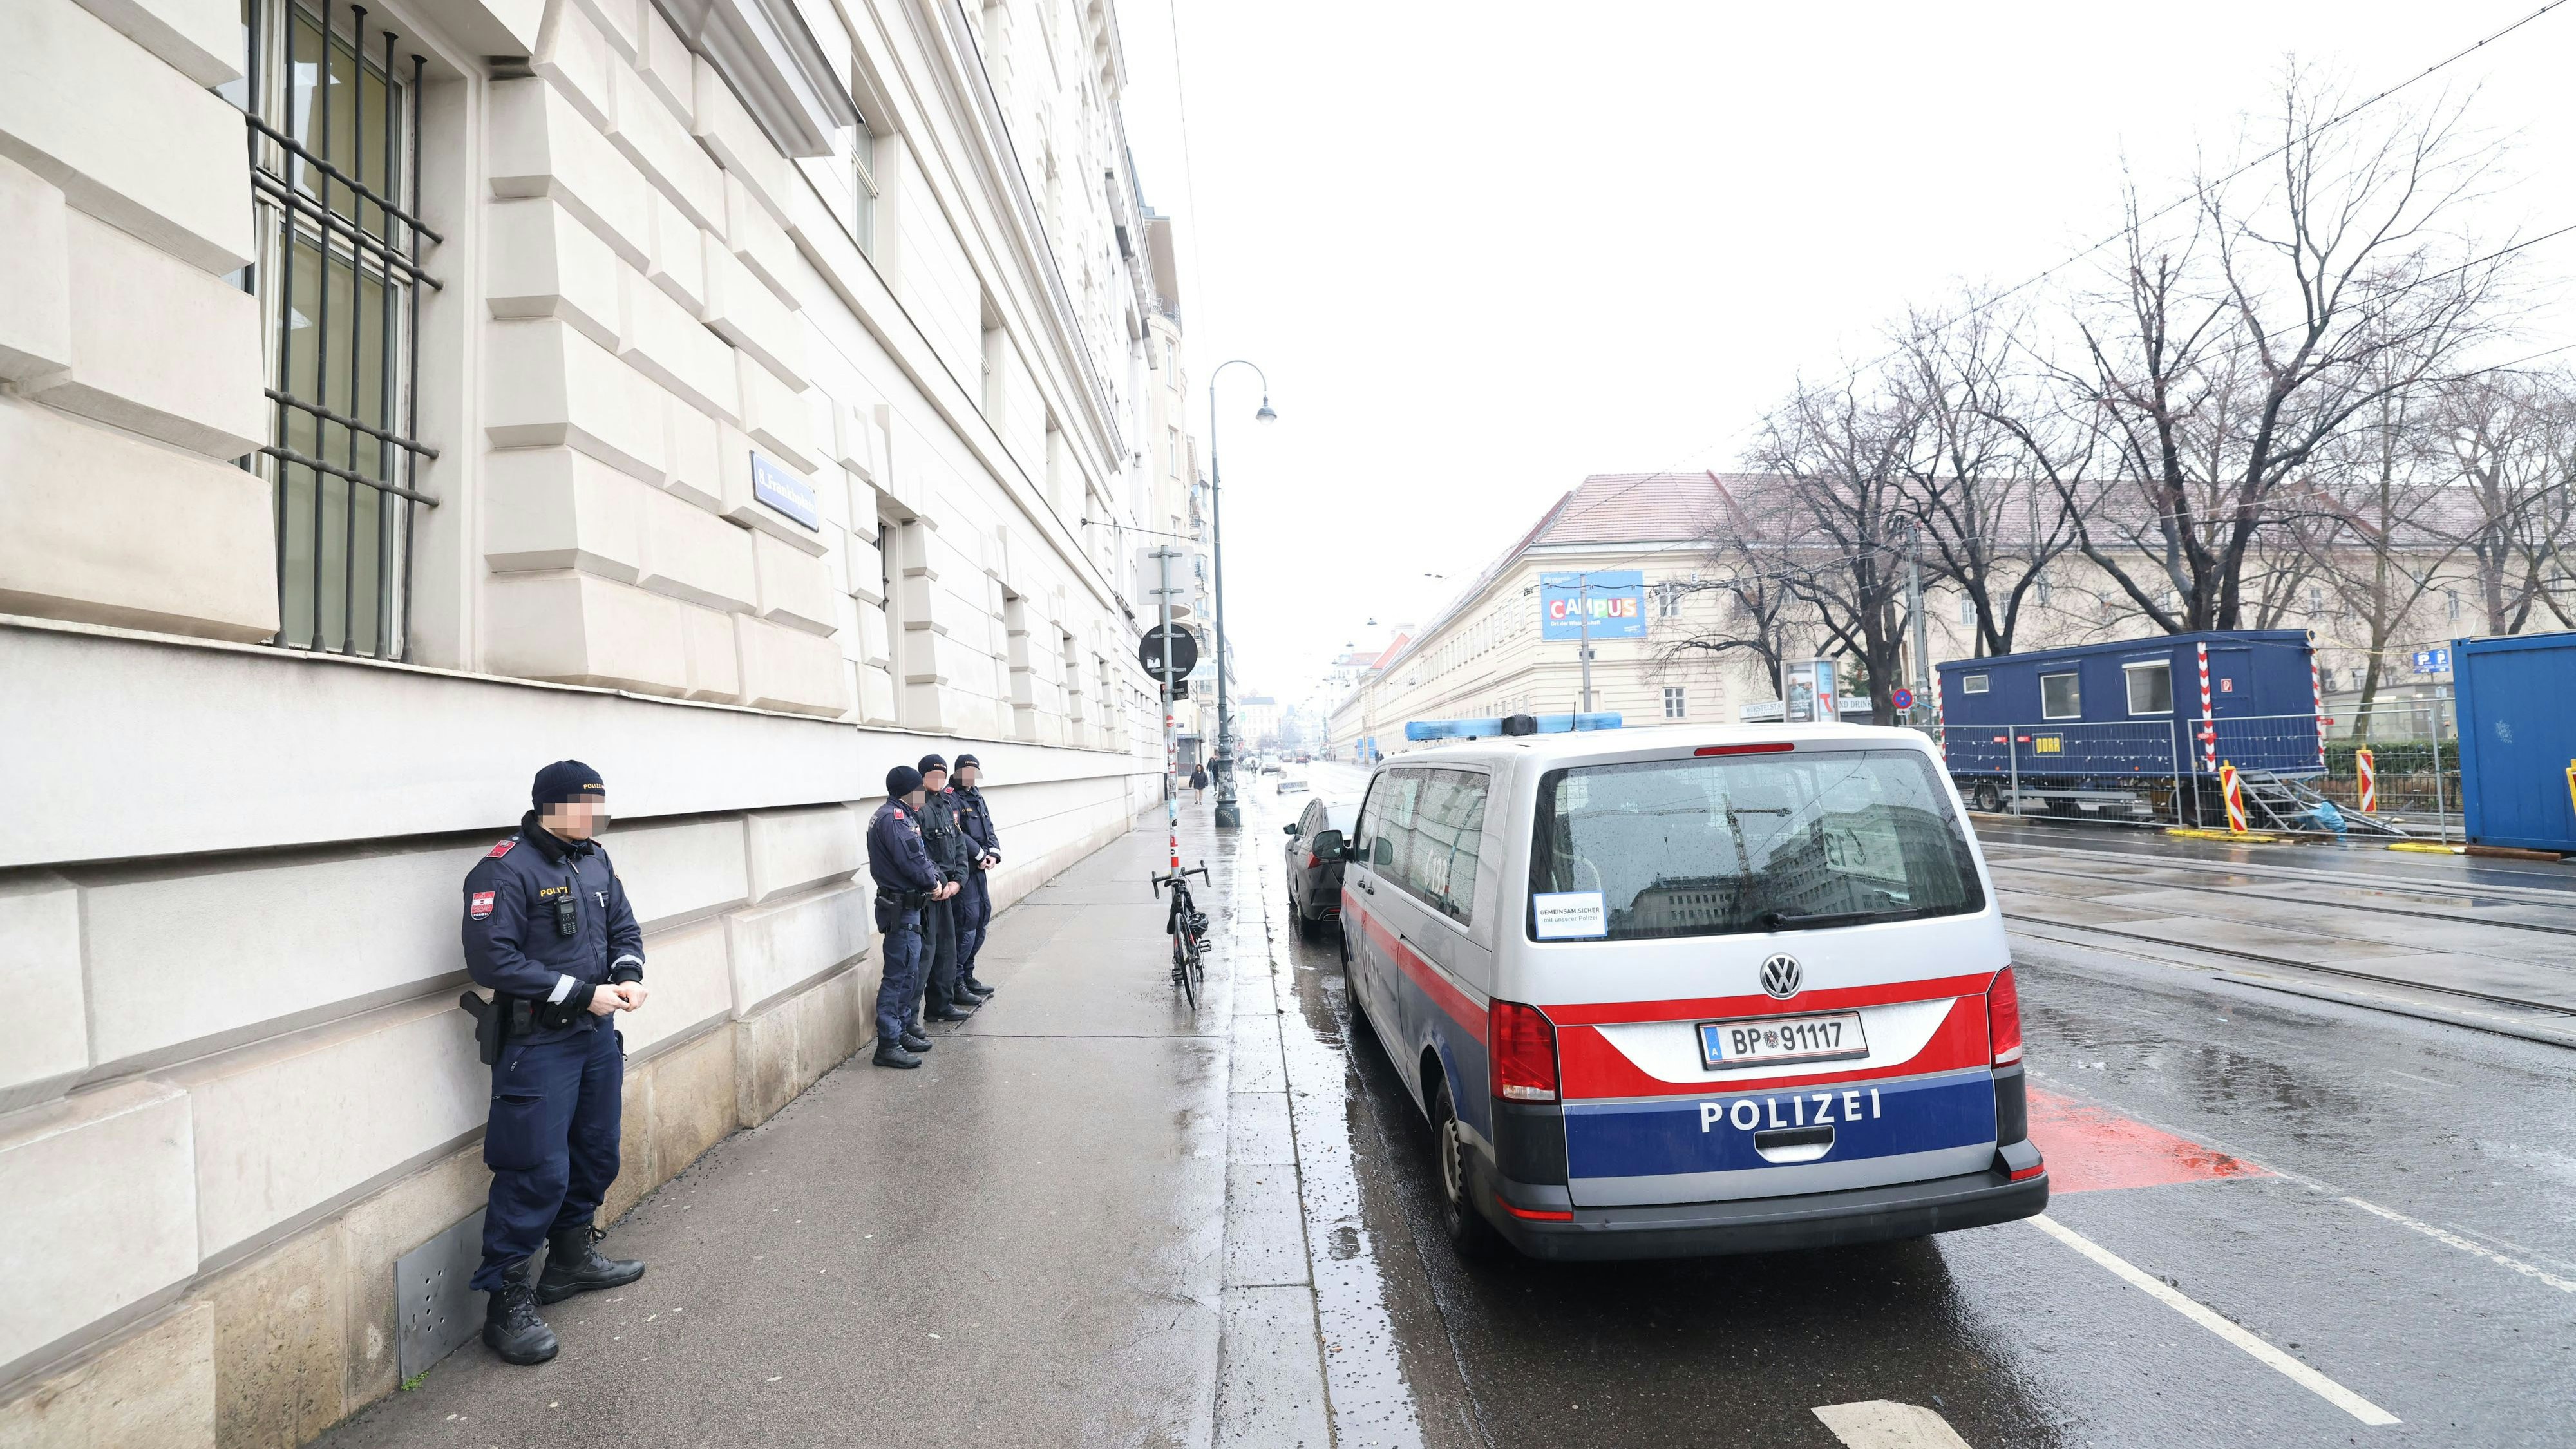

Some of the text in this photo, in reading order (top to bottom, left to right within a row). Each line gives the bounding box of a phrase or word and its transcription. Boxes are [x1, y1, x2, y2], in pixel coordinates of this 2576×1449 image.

[1551, 598, 1636, 619] CAMPUS
[2036, 737, 2061, 753] PORR
[1711, 1022, 1842, 1056] A BP 91117
[1700, 1088, 1881, 1133] POLIZEI
